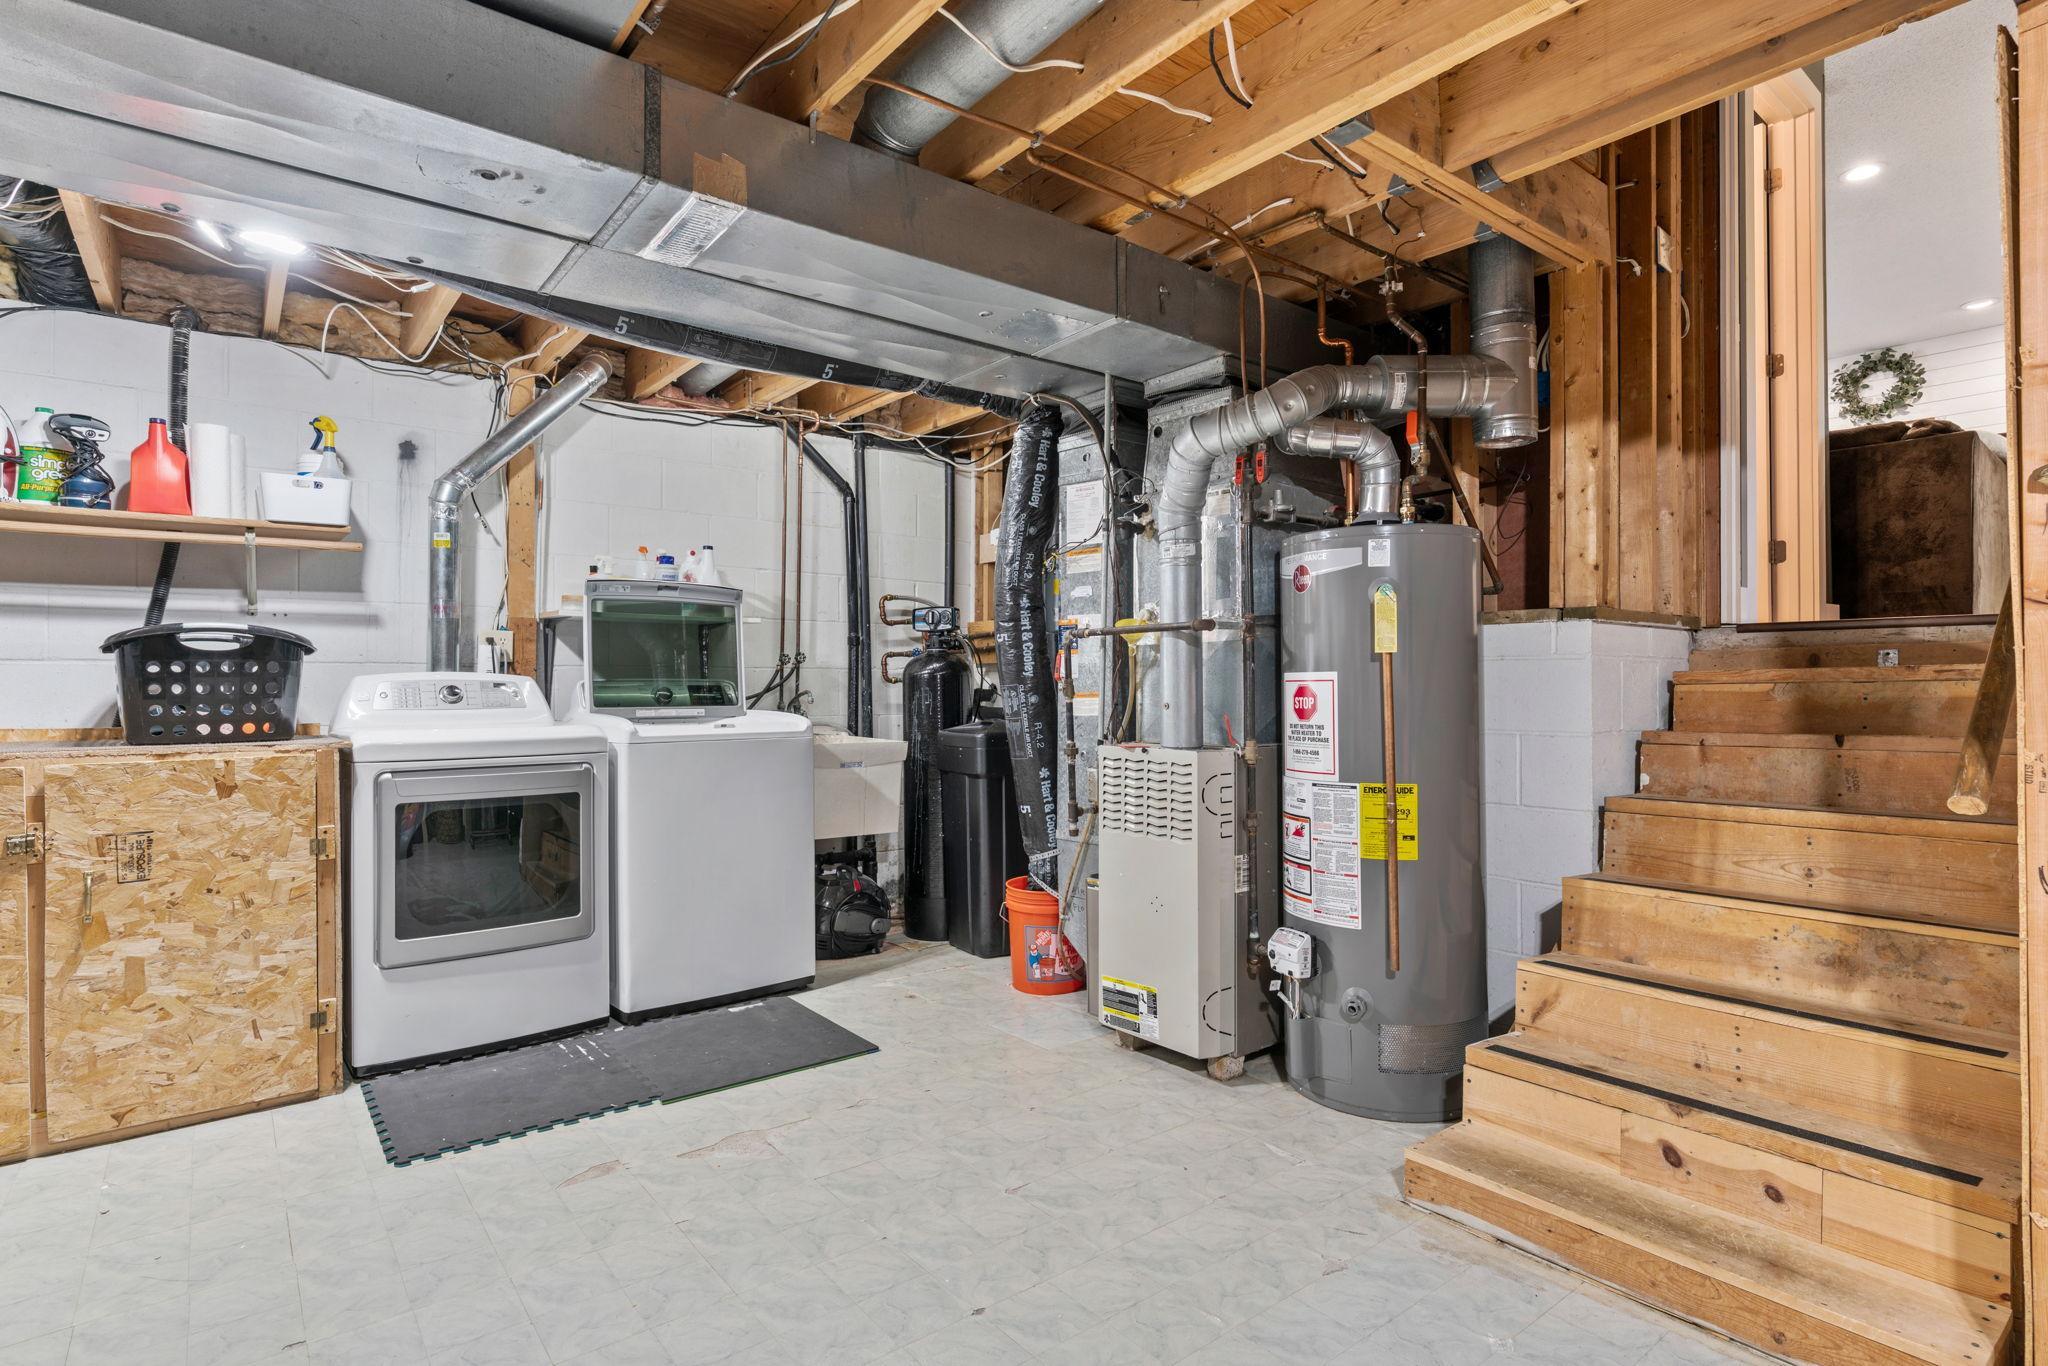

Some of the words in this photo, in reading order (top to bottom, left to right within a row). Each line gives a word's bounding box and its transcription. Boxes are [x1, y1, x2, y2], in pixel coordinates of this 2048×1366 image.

[1038, 440, 1052, 461] Hart
[1036, 462, 1048, 472] &
[1028, 474, 1046, 508] Cooley
[1020, 610, 1032, 630] Hart
[1022, 632, 1033, 642] &
[1022, 643, 1035, 677] Cooley
[1294, 696, 1315, 709] STOP
[1034, 722, 1045, 748] R-4.2
[1040, 780, 1053, 802] Hart
[1044, 804, 1055, 812] &
[1046, 814, 1057, 849] Cooley
[136, 840, 146, 880] EXPOSURE
